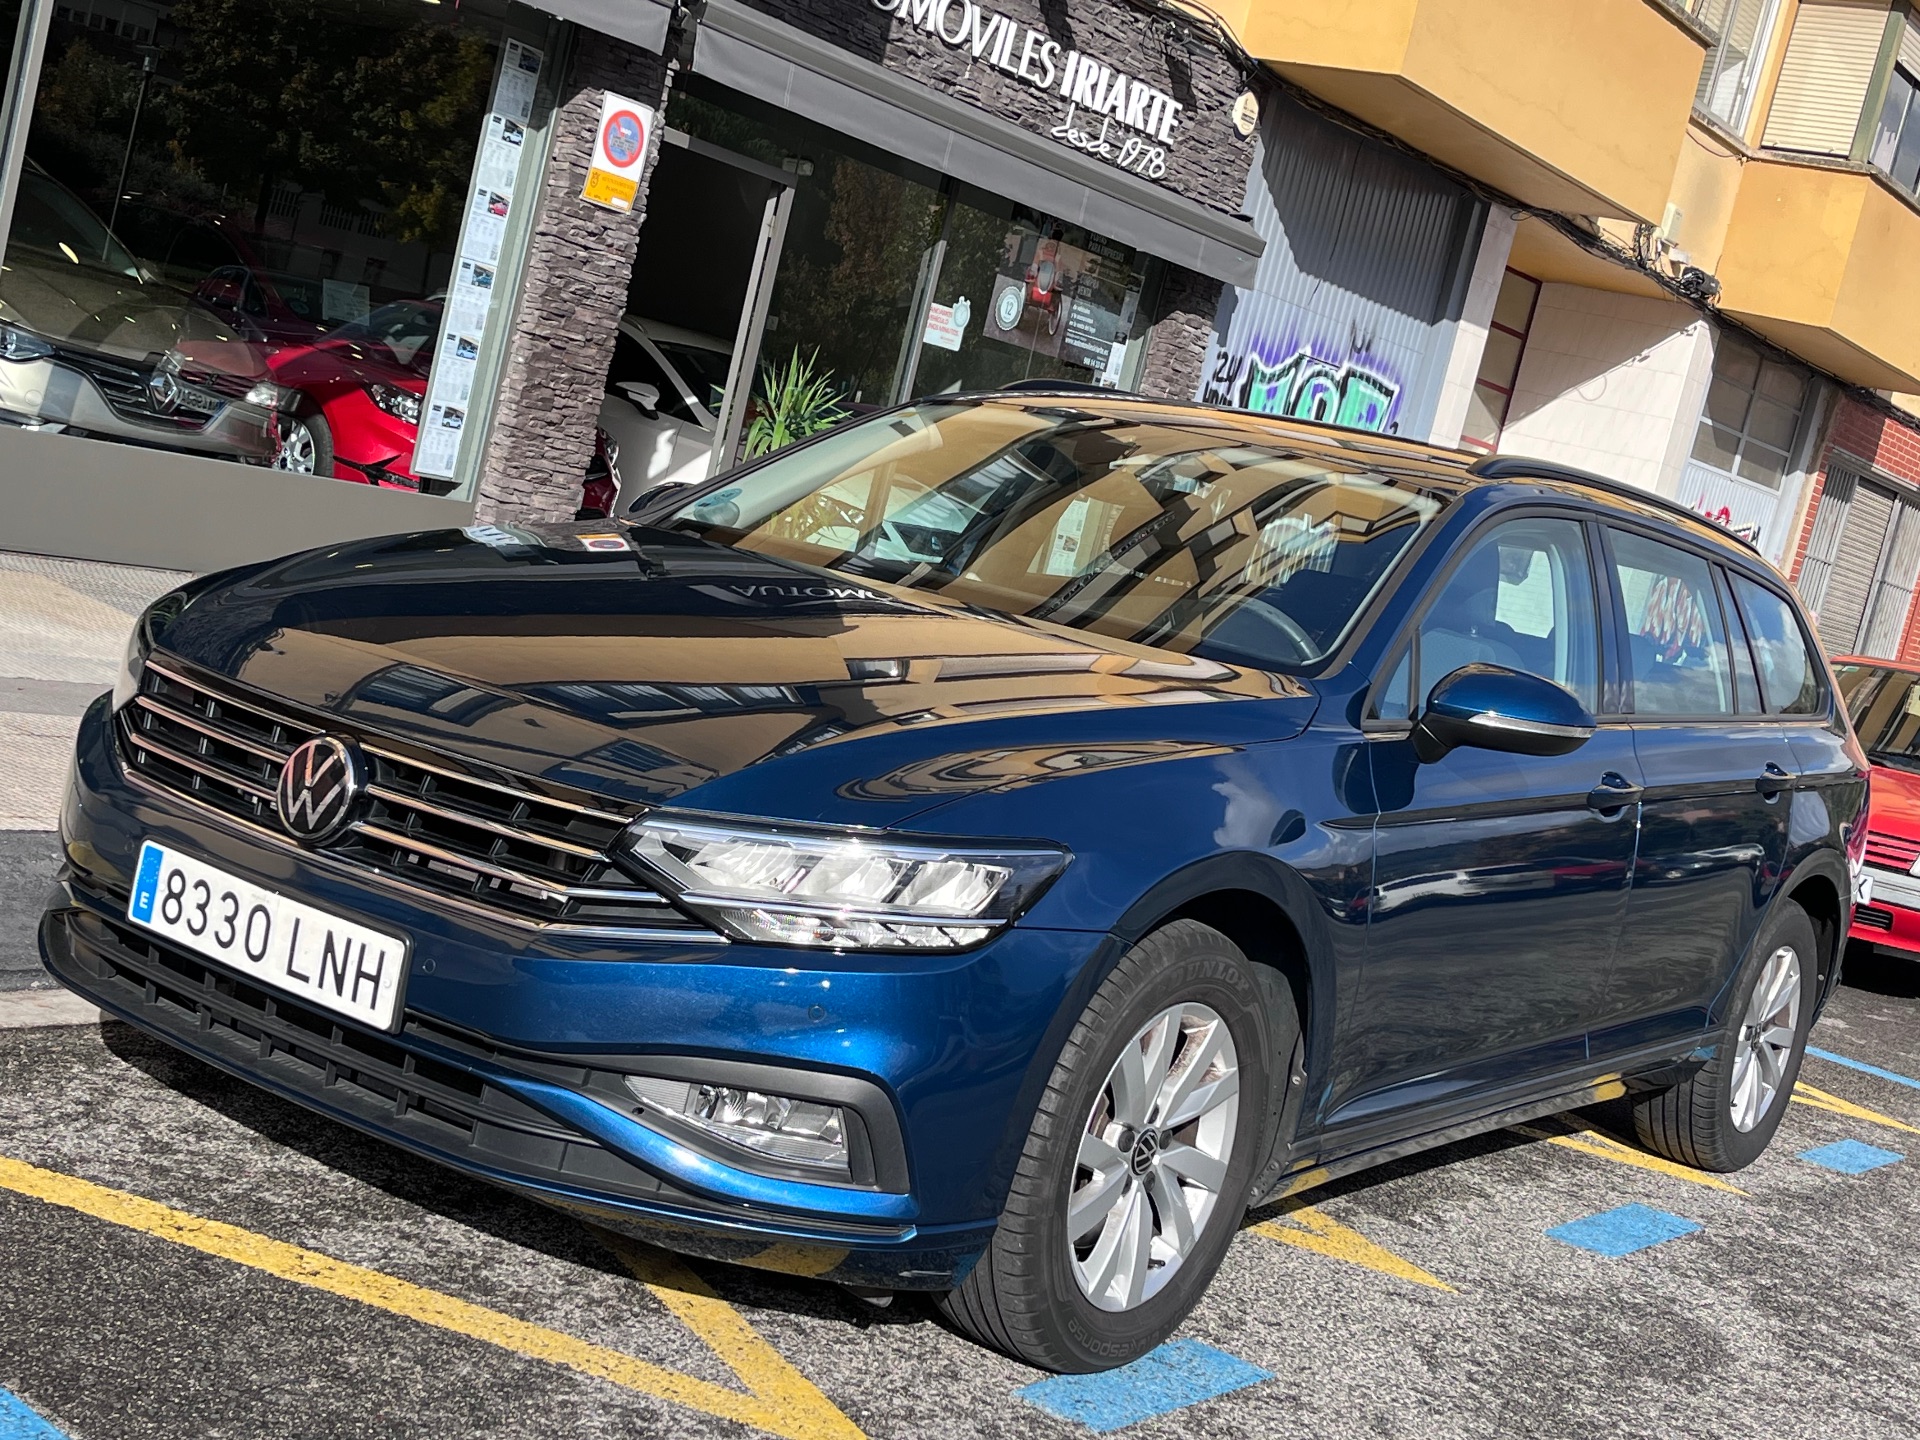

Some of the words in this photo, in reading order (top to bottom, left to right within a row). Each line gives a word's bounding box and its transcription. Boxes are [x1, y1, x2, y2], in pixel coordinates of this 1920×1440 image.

[870, 0, 1061, 89] MOVILES
[1060, 50, 1183, 146] IRIARTE
[1050, 101, 1114, 160] desde
[1116, 137, 1167, 179] 1978
[138, 890, 151, 910] E
[161, 868, 271, 963] 8330
[286, 917, 386, 1011] LNH
